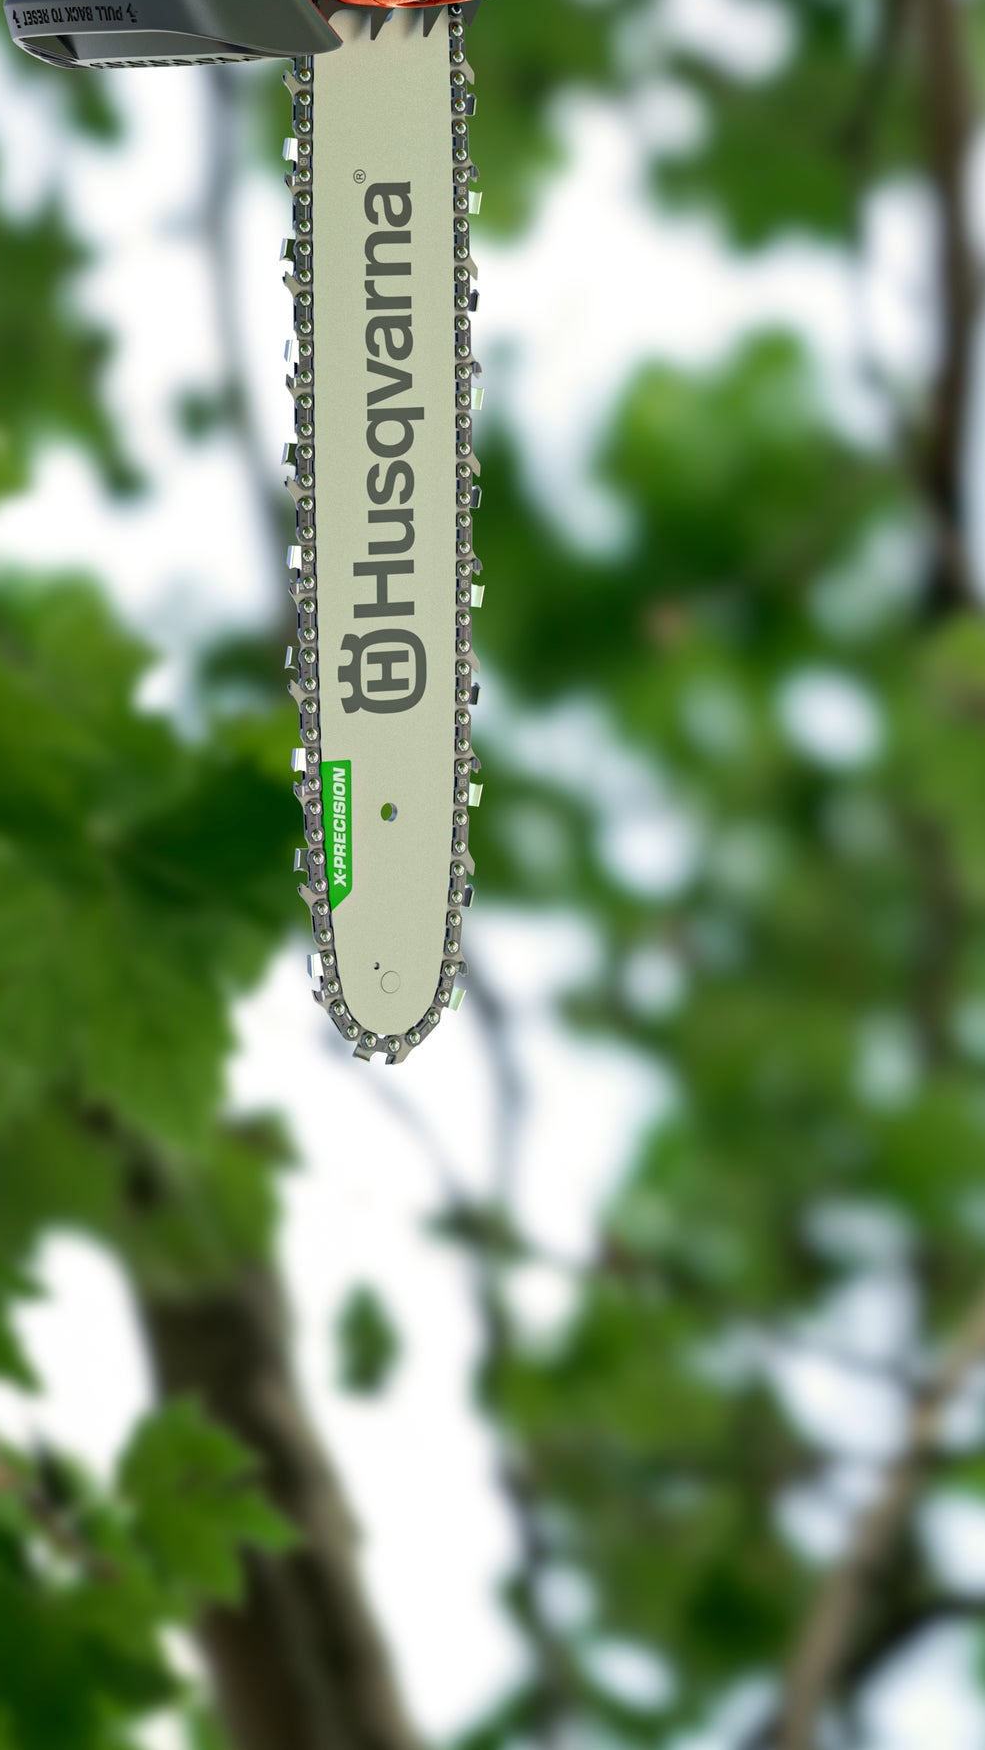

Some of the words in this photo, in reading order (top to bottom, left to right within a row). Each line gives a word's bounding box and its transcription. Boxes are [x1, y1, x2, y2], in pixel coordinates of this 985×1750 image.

[22, 8, 50, 26] RESET
[50, 7, 64, 24] TO
[64, 6, 94, 22] BACK
[95, 5, 123, 22] PULL
[331, 766, 347, 888] X-PRECISION
